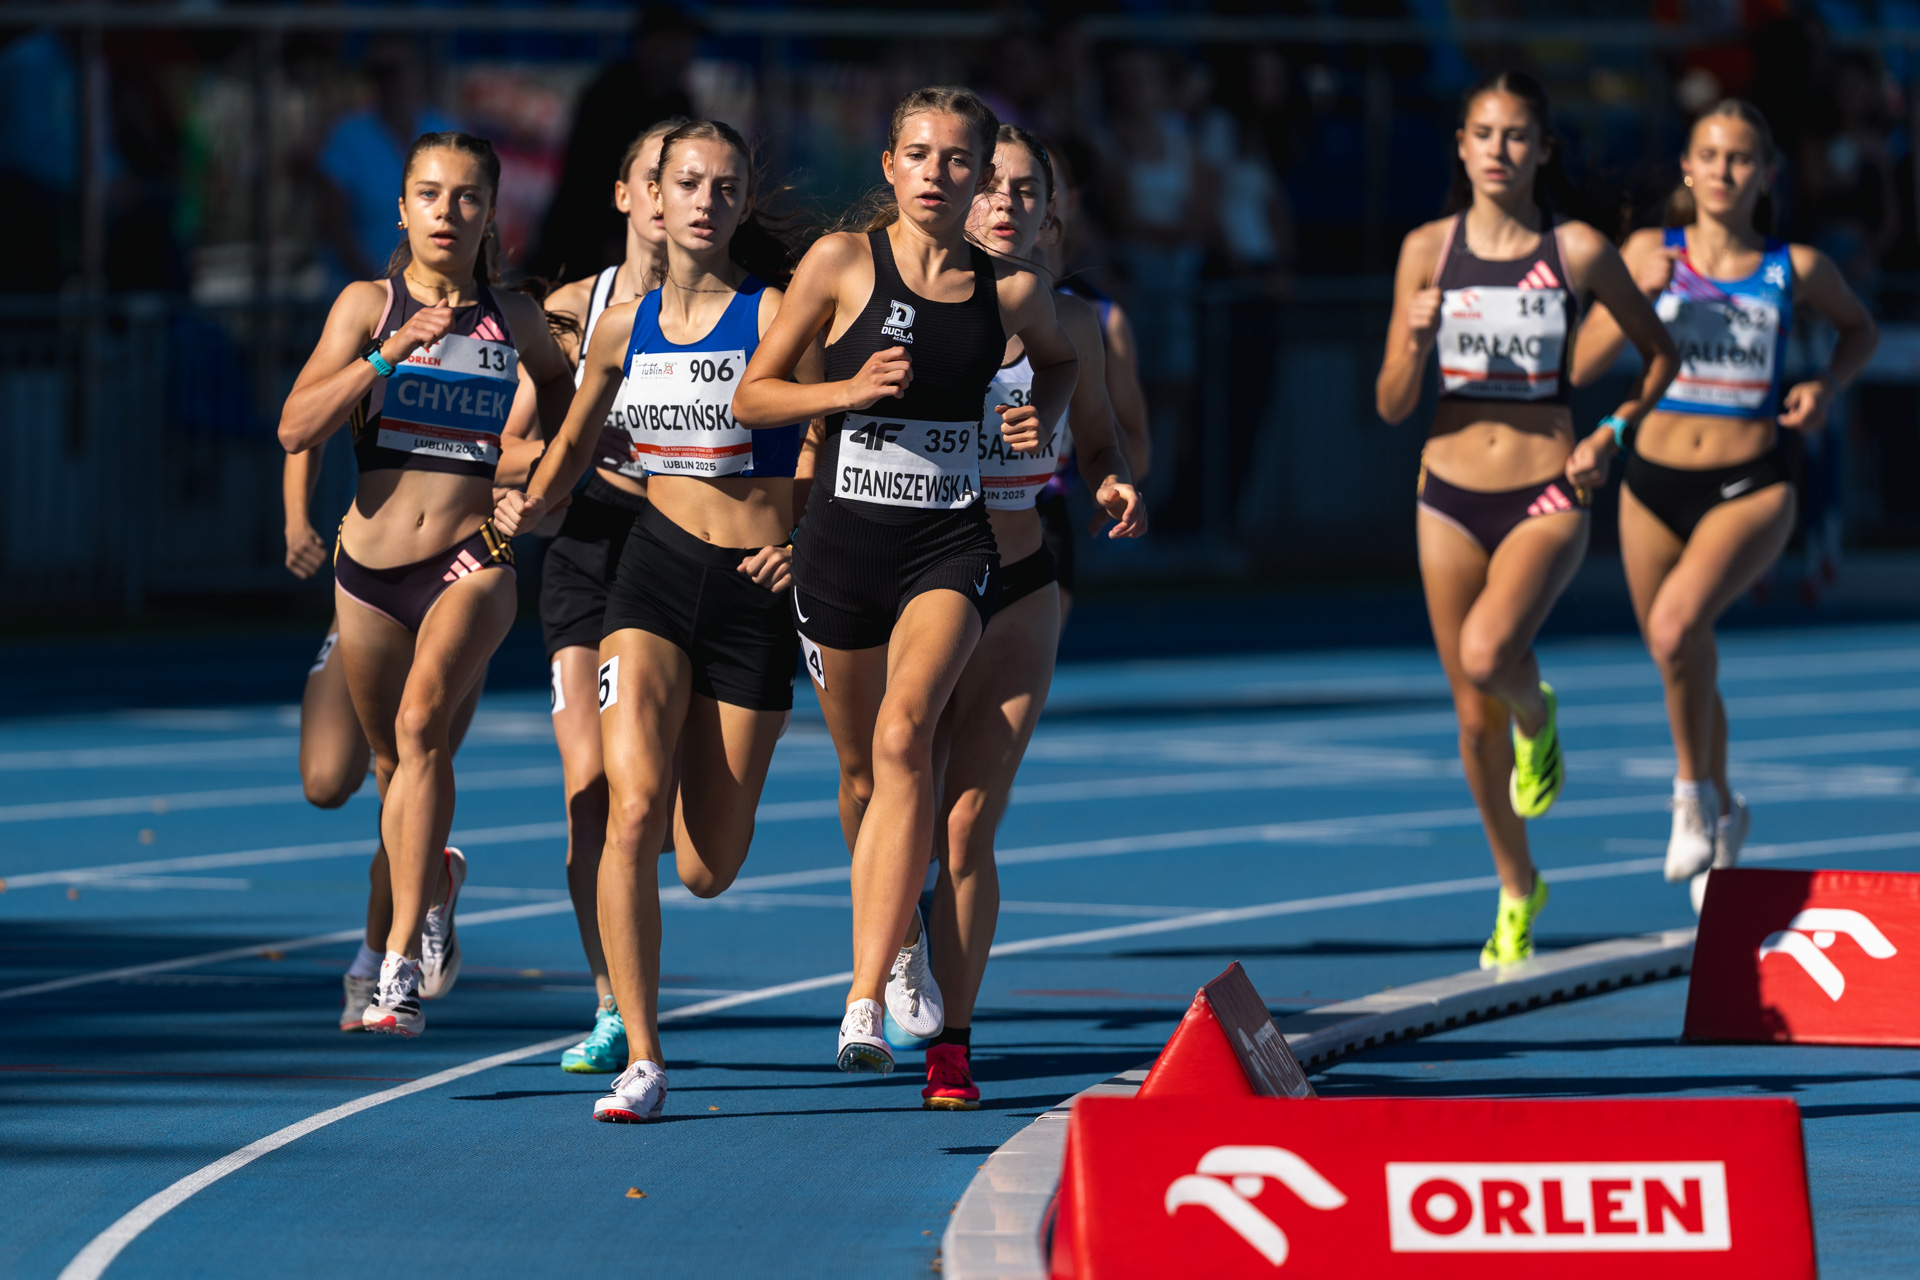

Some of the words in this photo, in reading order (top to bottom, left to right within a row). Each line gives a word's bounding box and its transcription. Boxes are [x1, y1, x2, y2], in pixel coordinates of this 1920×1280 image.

[1518, 296, 1545, 317] 14
[881, 326, 914, 341] DUCLA
[407, 354, 442, 367] ORLEN
[478, 347, 506, 372] 13
[1677, 339, 1768, 369] ALLON
[689, 358, 734, 383] 906
[397, 379, 507, 421] CHYŁEK
[414, 438, 453, 453] LUBLIN
[455, 444, 484, 455] 2025
[848, 421, 906, 451] 4F
[923, 428, 971, 453] 359
[662, 460, 694, 470] LUBLIN
[695, 461, 717, 471] 2025
[841, 465, 975, 502] STANISZEWSKA
[1002, 490, 1026, 500] 2025
[809, 649, 823, 679] 4
[599, 663, 611, 709] 5
[1409, 1176, 1705, 1236] ORLEN
